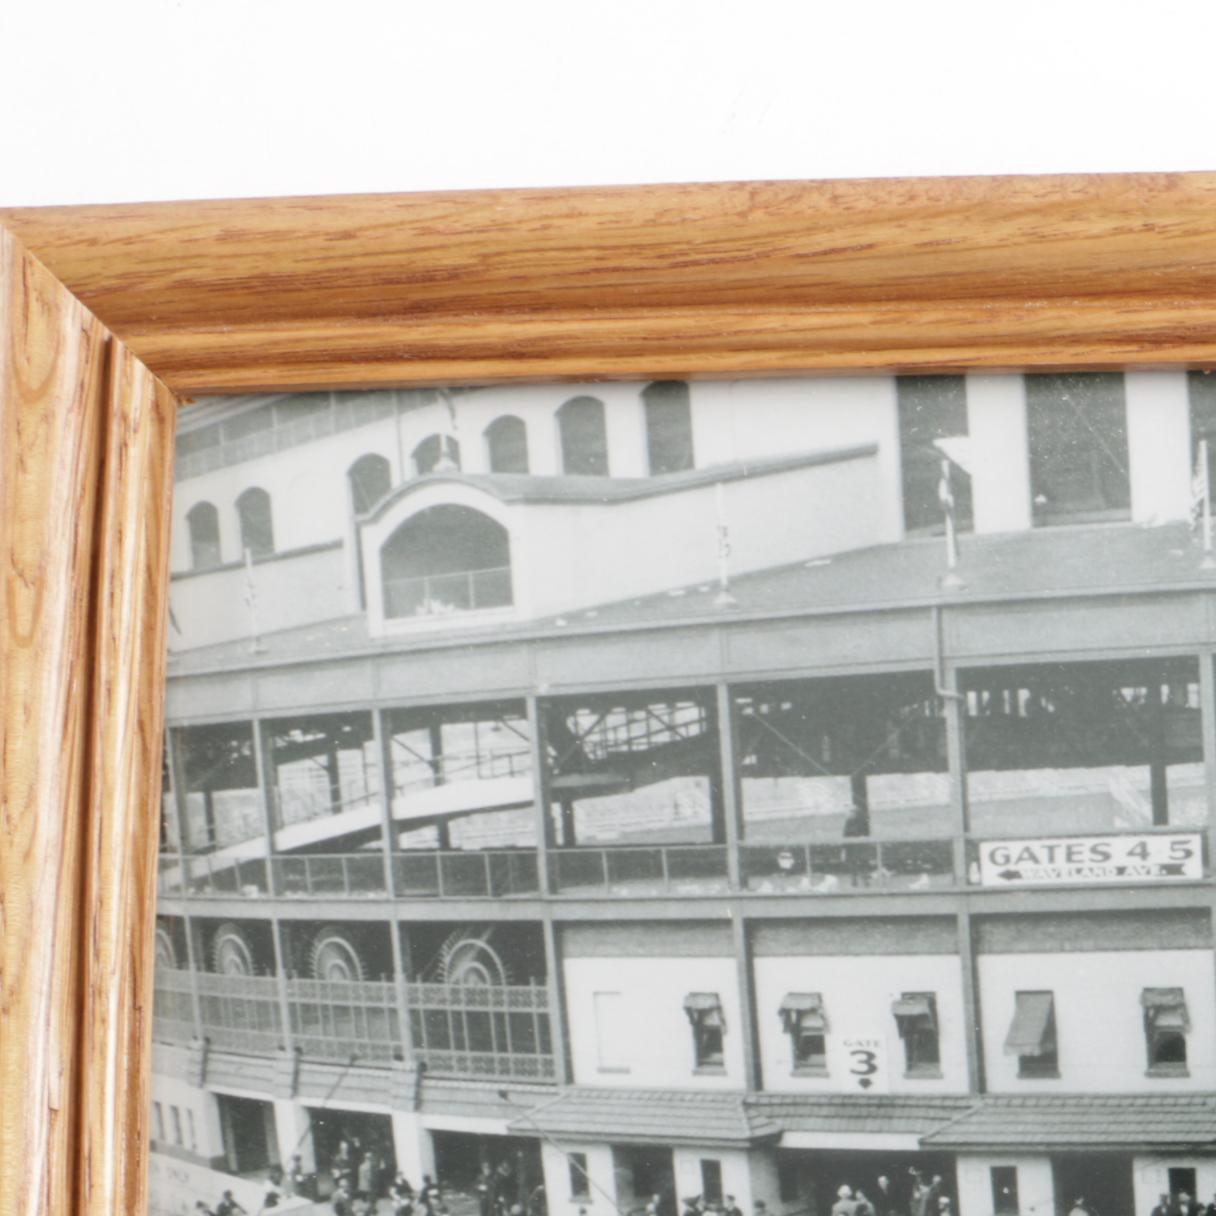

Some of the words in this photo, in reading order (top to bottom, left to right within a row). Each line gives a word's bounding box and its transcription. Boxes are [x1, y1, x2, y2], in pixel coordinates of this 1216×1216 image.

[988, 842, 1112, 867] GATES
[1126, 840, 1151, 863] 4
[1168, 839, 1194, 861] 5
[842, 1039, 880, 1048] GATE
[849, 1050, 879, 1076] 3
